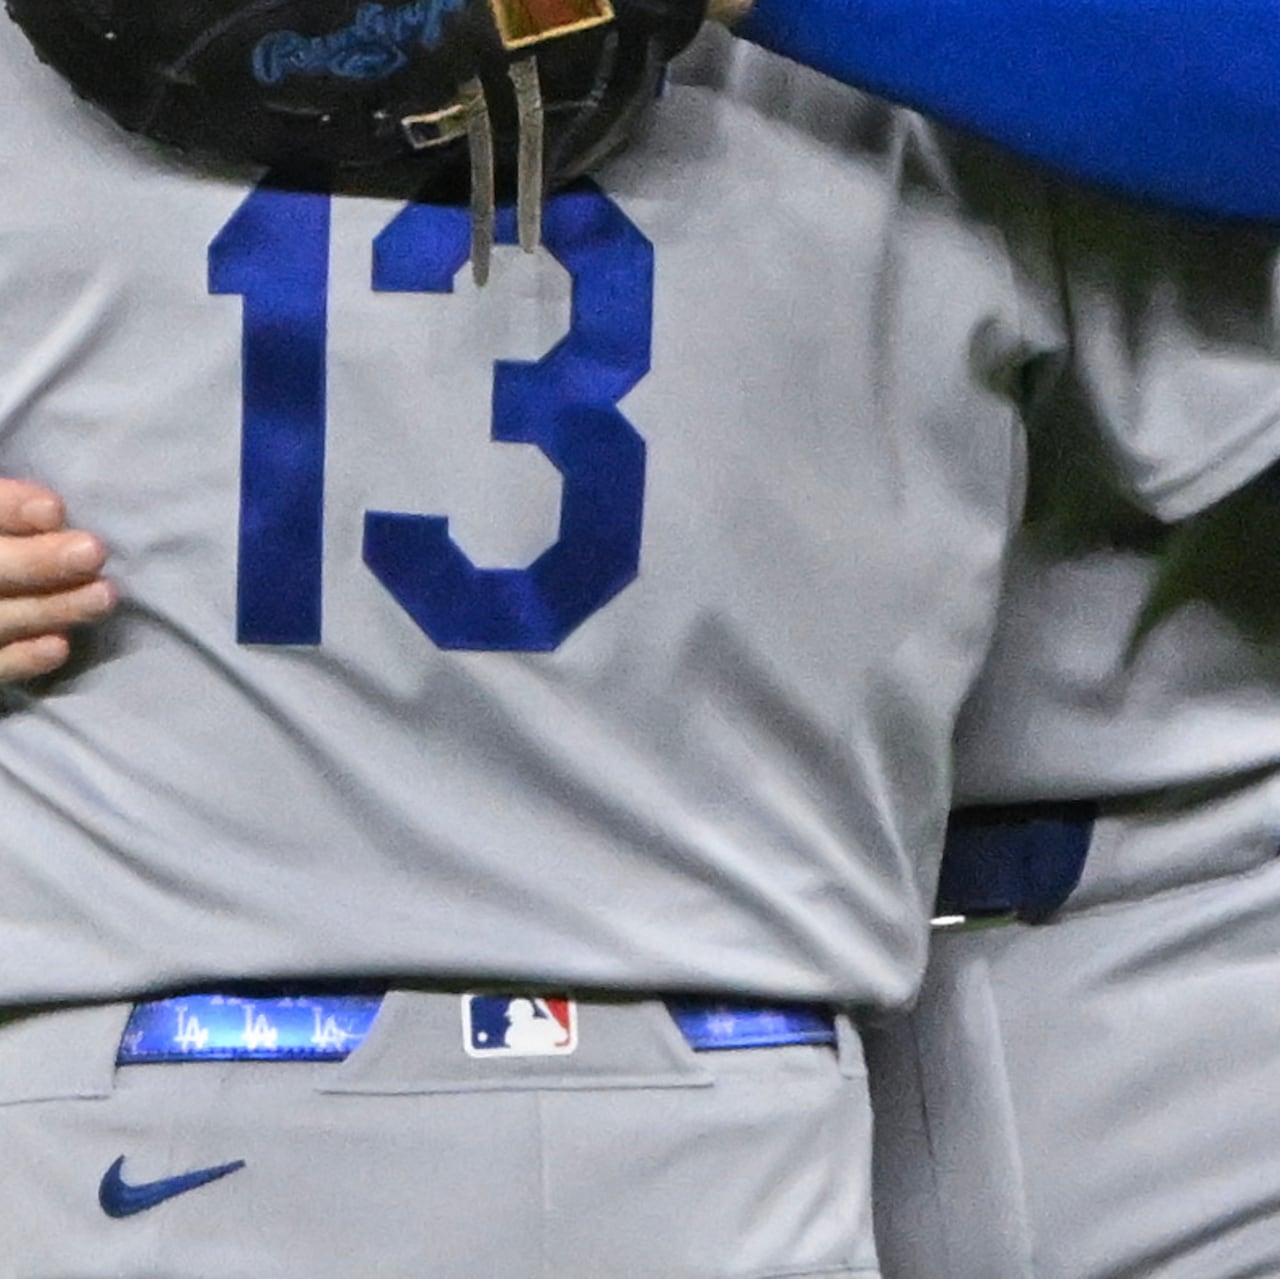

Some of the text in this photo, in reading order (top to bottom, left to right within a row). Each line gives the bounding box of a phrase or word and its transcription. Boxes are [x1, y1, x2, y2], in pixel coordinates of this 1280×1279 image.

[207, 176, 655, 653] 13
[173, 1004, 209, 1050] LA
[240, 1003, 278, 1050] LA
